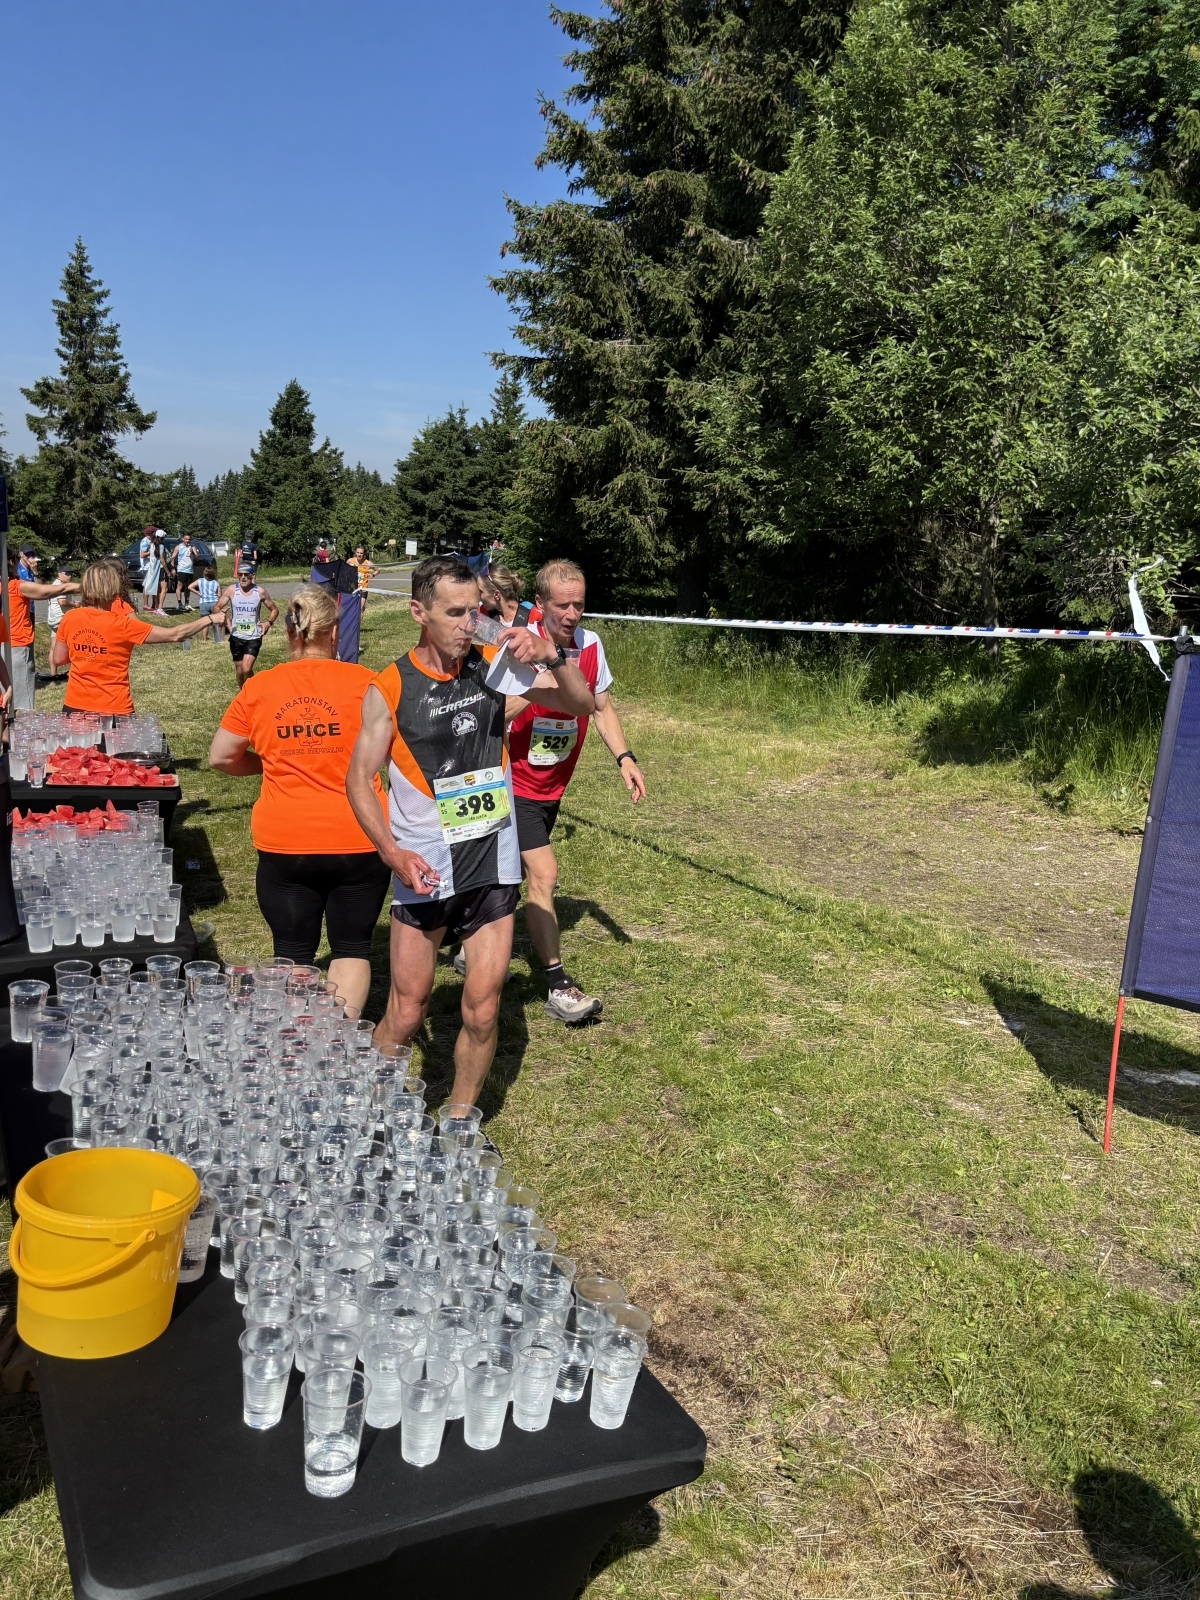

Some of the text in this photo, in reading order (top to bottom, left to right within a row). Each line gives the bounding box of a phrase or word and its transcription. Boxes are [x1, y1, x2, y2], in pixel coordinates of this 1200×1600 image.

[275, 696, 338, 720] MARATONSTAV
[542, 736, 569, 749] 529
[454, 792, 496, 817] 398
